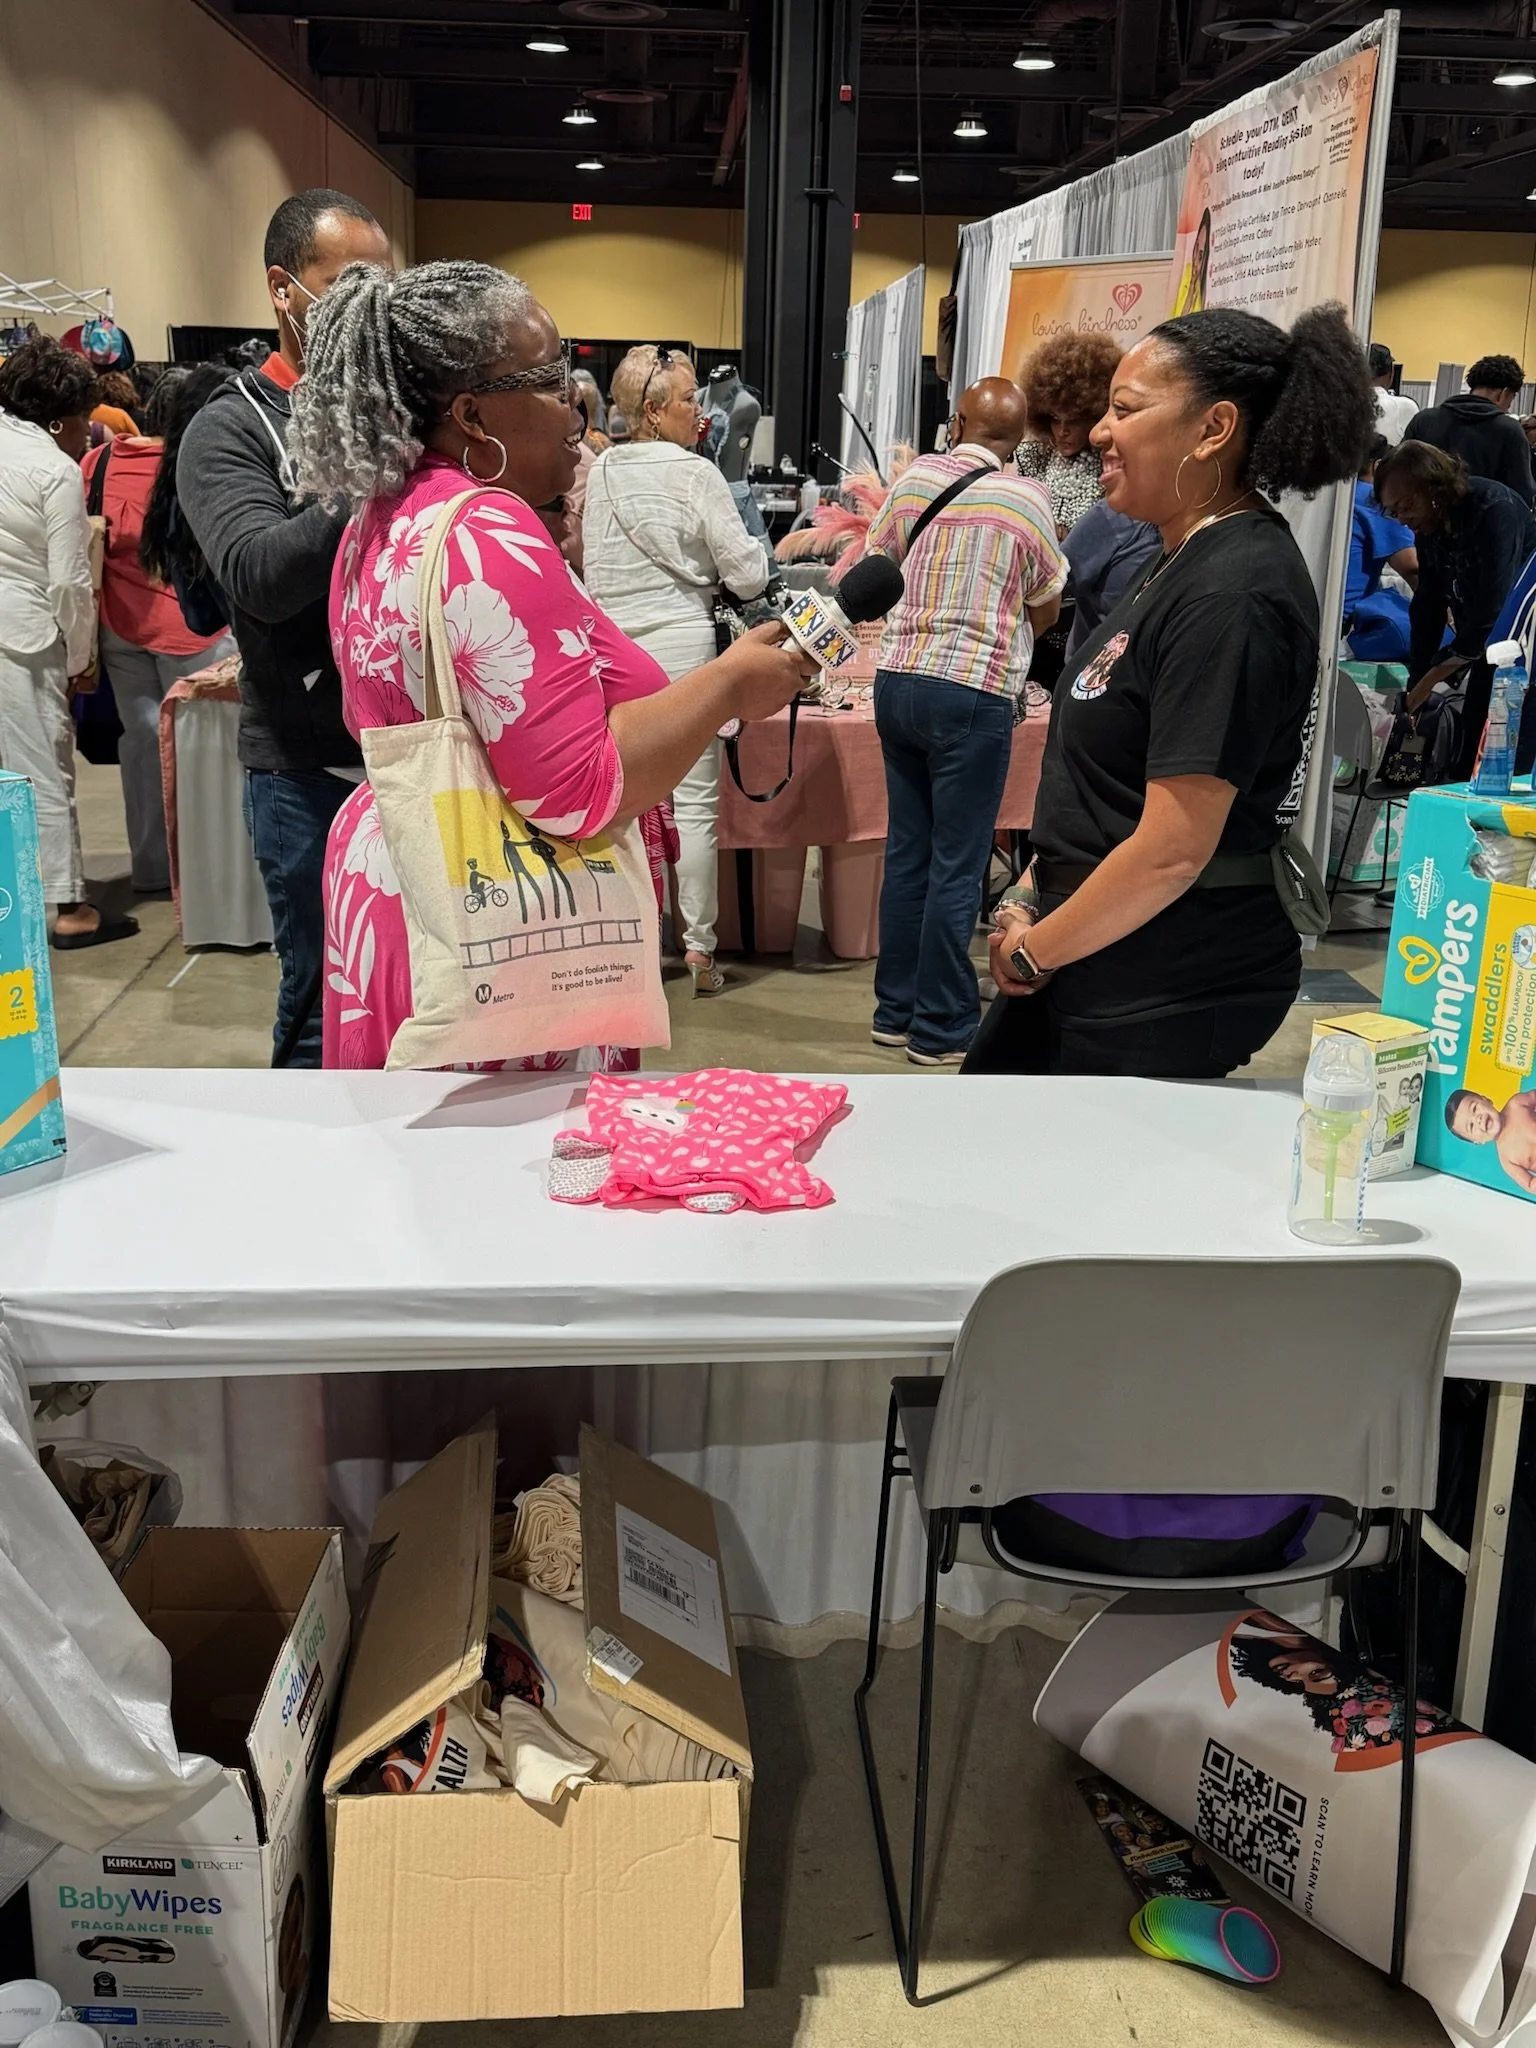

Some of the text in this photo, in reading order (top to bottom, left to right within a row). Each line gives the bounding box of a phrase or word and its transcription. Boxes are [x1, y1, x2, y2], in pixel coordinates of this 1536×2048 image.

[1243, 160, 1266, 180] today!
[572, 204, 593, 221] EXIT
[1275, 815, 1292, 826] Scan
[1419, 860, 1433, 916] PEDIATRICIAN
[551, 961, 635, 981] Don't do foolish things.
[565, 979, 584, 992] good
[586, 978, 593, 987] to
[595, 976, 603, 986] be
[605, 973, 623, 983] alive!
[9, 985, 24, 1008] 2
[493, 992, 515, 1005] Metro
[1480, 943, 1507, 1056] swaddlers
[1512, 971, 1524, 1017] LEAKPROOF
[1517, 1043, 1528, 1067] skin
[432, 1736, 468, 1791] ALTH
[1317, 1797, 1330, 1830] SCAN
[1314, 1833, 1324, 1849] TO
[106, 1857, 173, 1870] KIRKLAND
[1308, 1850, 1322, 1889] LEARN
[71, 1920, 214, 1935] FRAGRANCE FREE
